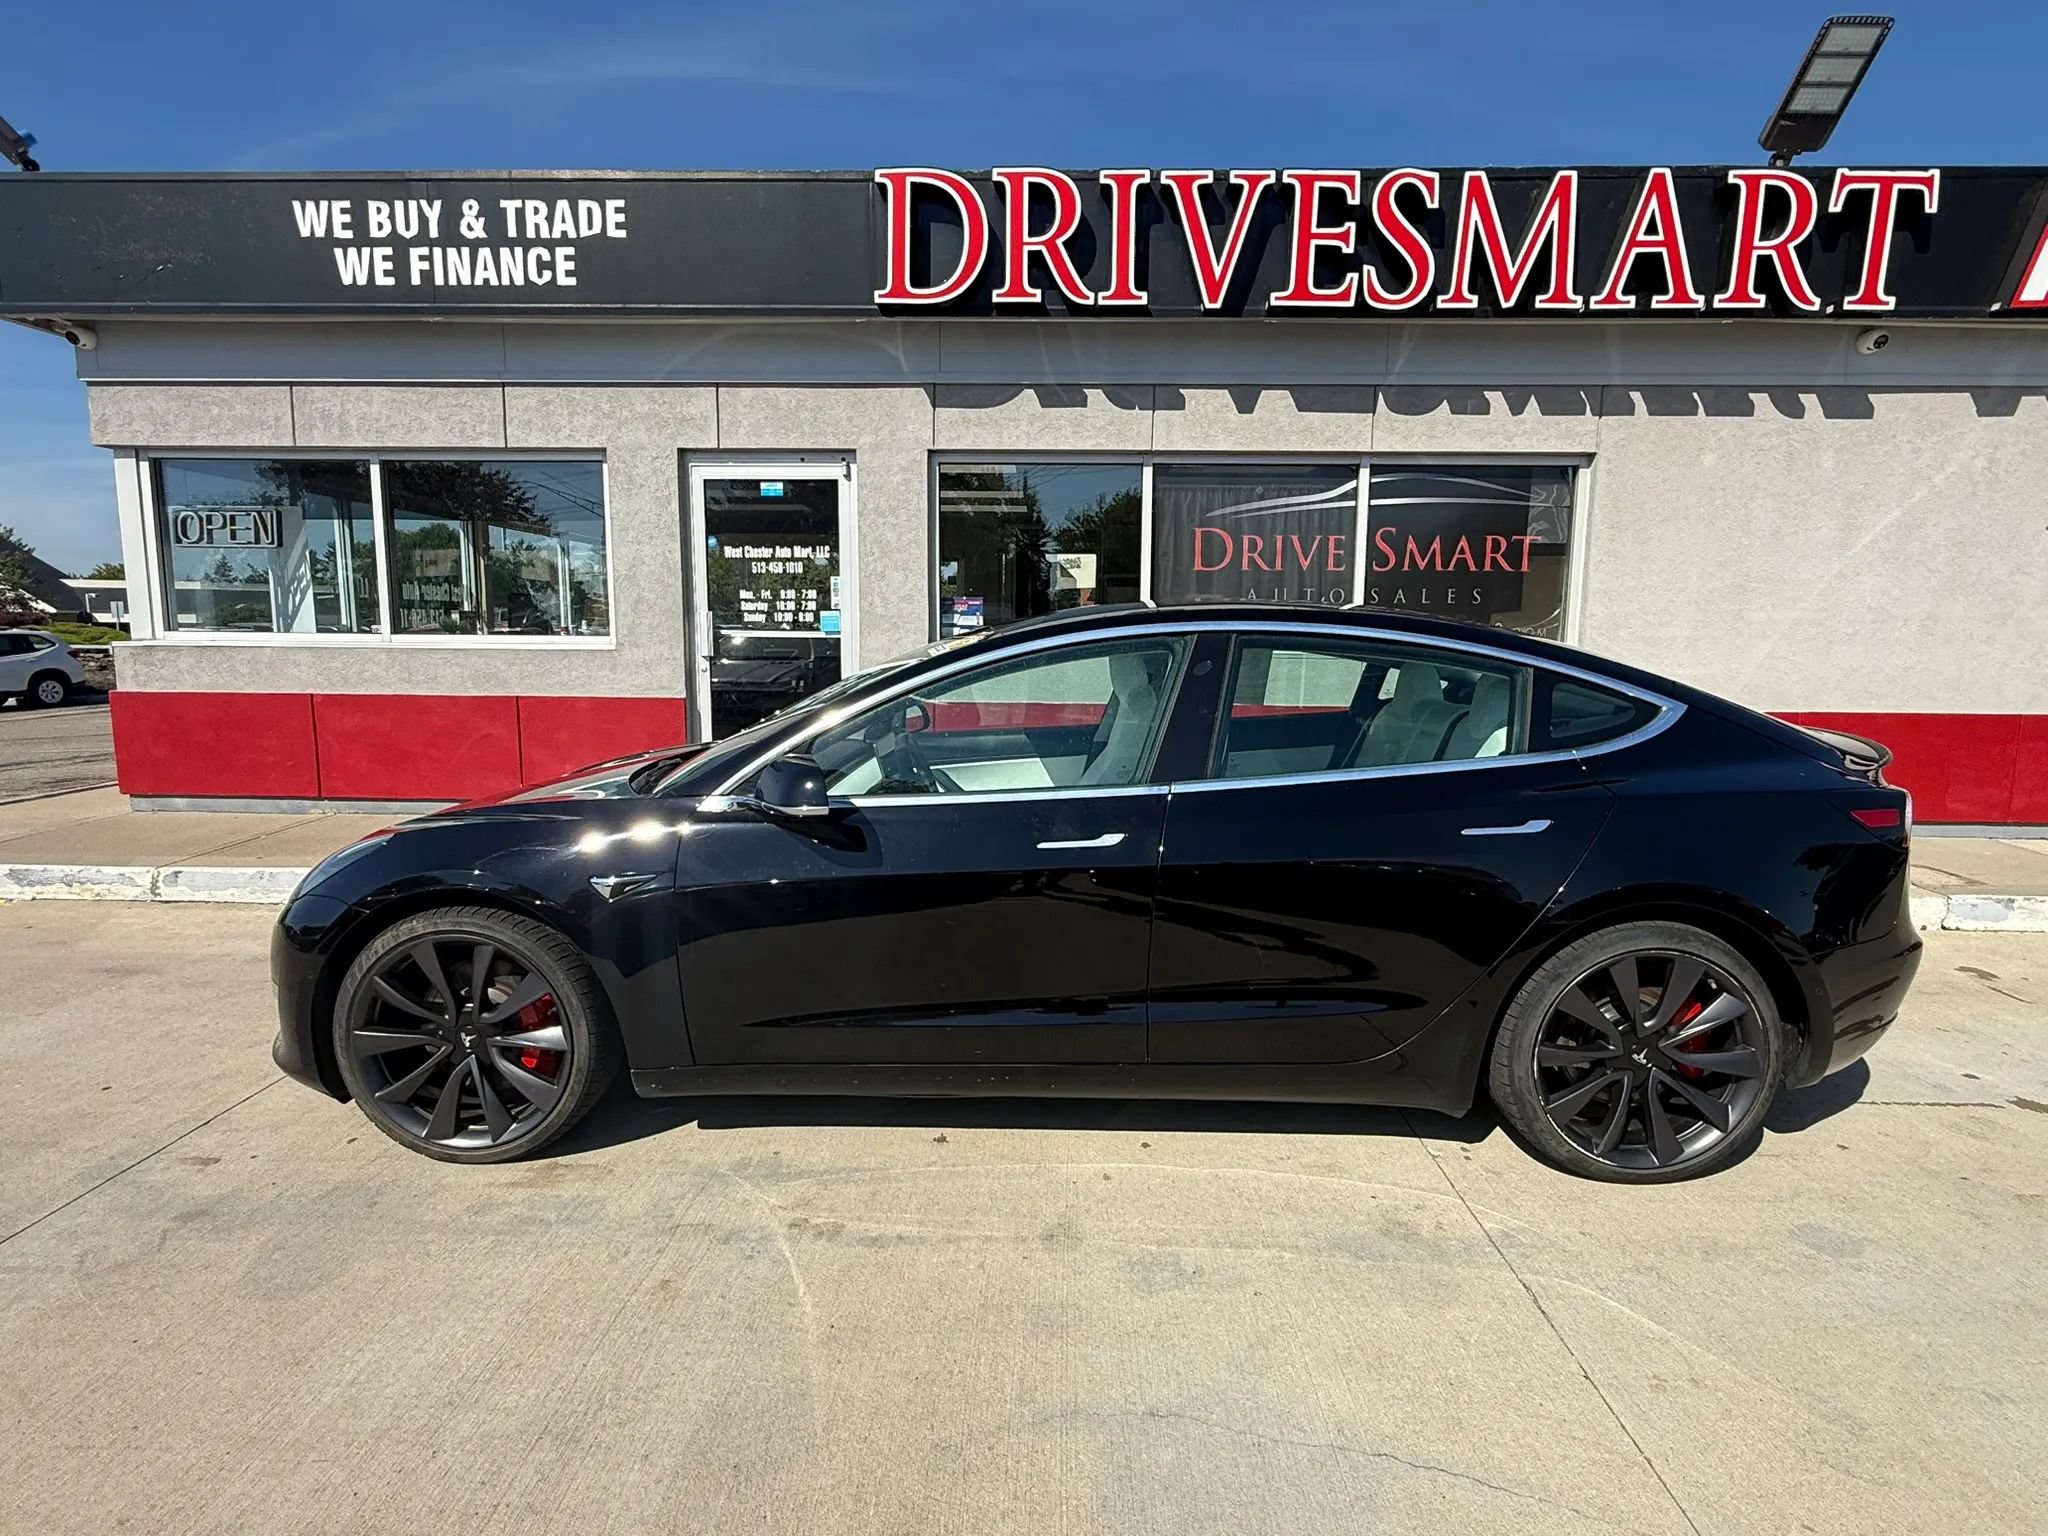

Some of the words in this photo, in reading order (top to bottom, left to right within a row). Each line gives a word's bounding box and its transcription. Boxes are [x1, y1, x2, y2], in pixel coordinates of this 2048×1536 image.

[292, 200, 353, 238] WE
[367, 199, 442, 239] BUY
[459, 199, 488, 239] &
[500, 199, 627, 238] TRADE
[874, 167, 1940, 312] DRIVESMART
[333, 247, 396, 286] WE
[409, 246, 577, 286] FINANCE
[176, 511, 275, 545] OPEN
[723, 545, 743, 558] West
[744, 545, 773, 558] Chester
[775, 545, 792, 558] Auto
[816, 545, 830, 558] LLC
[1192, 527, 1346, 572] DRIVE
[1373, 527, 1542, 572] SMART
[740, 600, 769, 612] Saturday
[1247, 588, 1345, 604] AUTO
[1370, 588, 1482, 604] SALES
[743, 611, 767, 624] Sunday
[773, 611, 794, 622] 10:00
